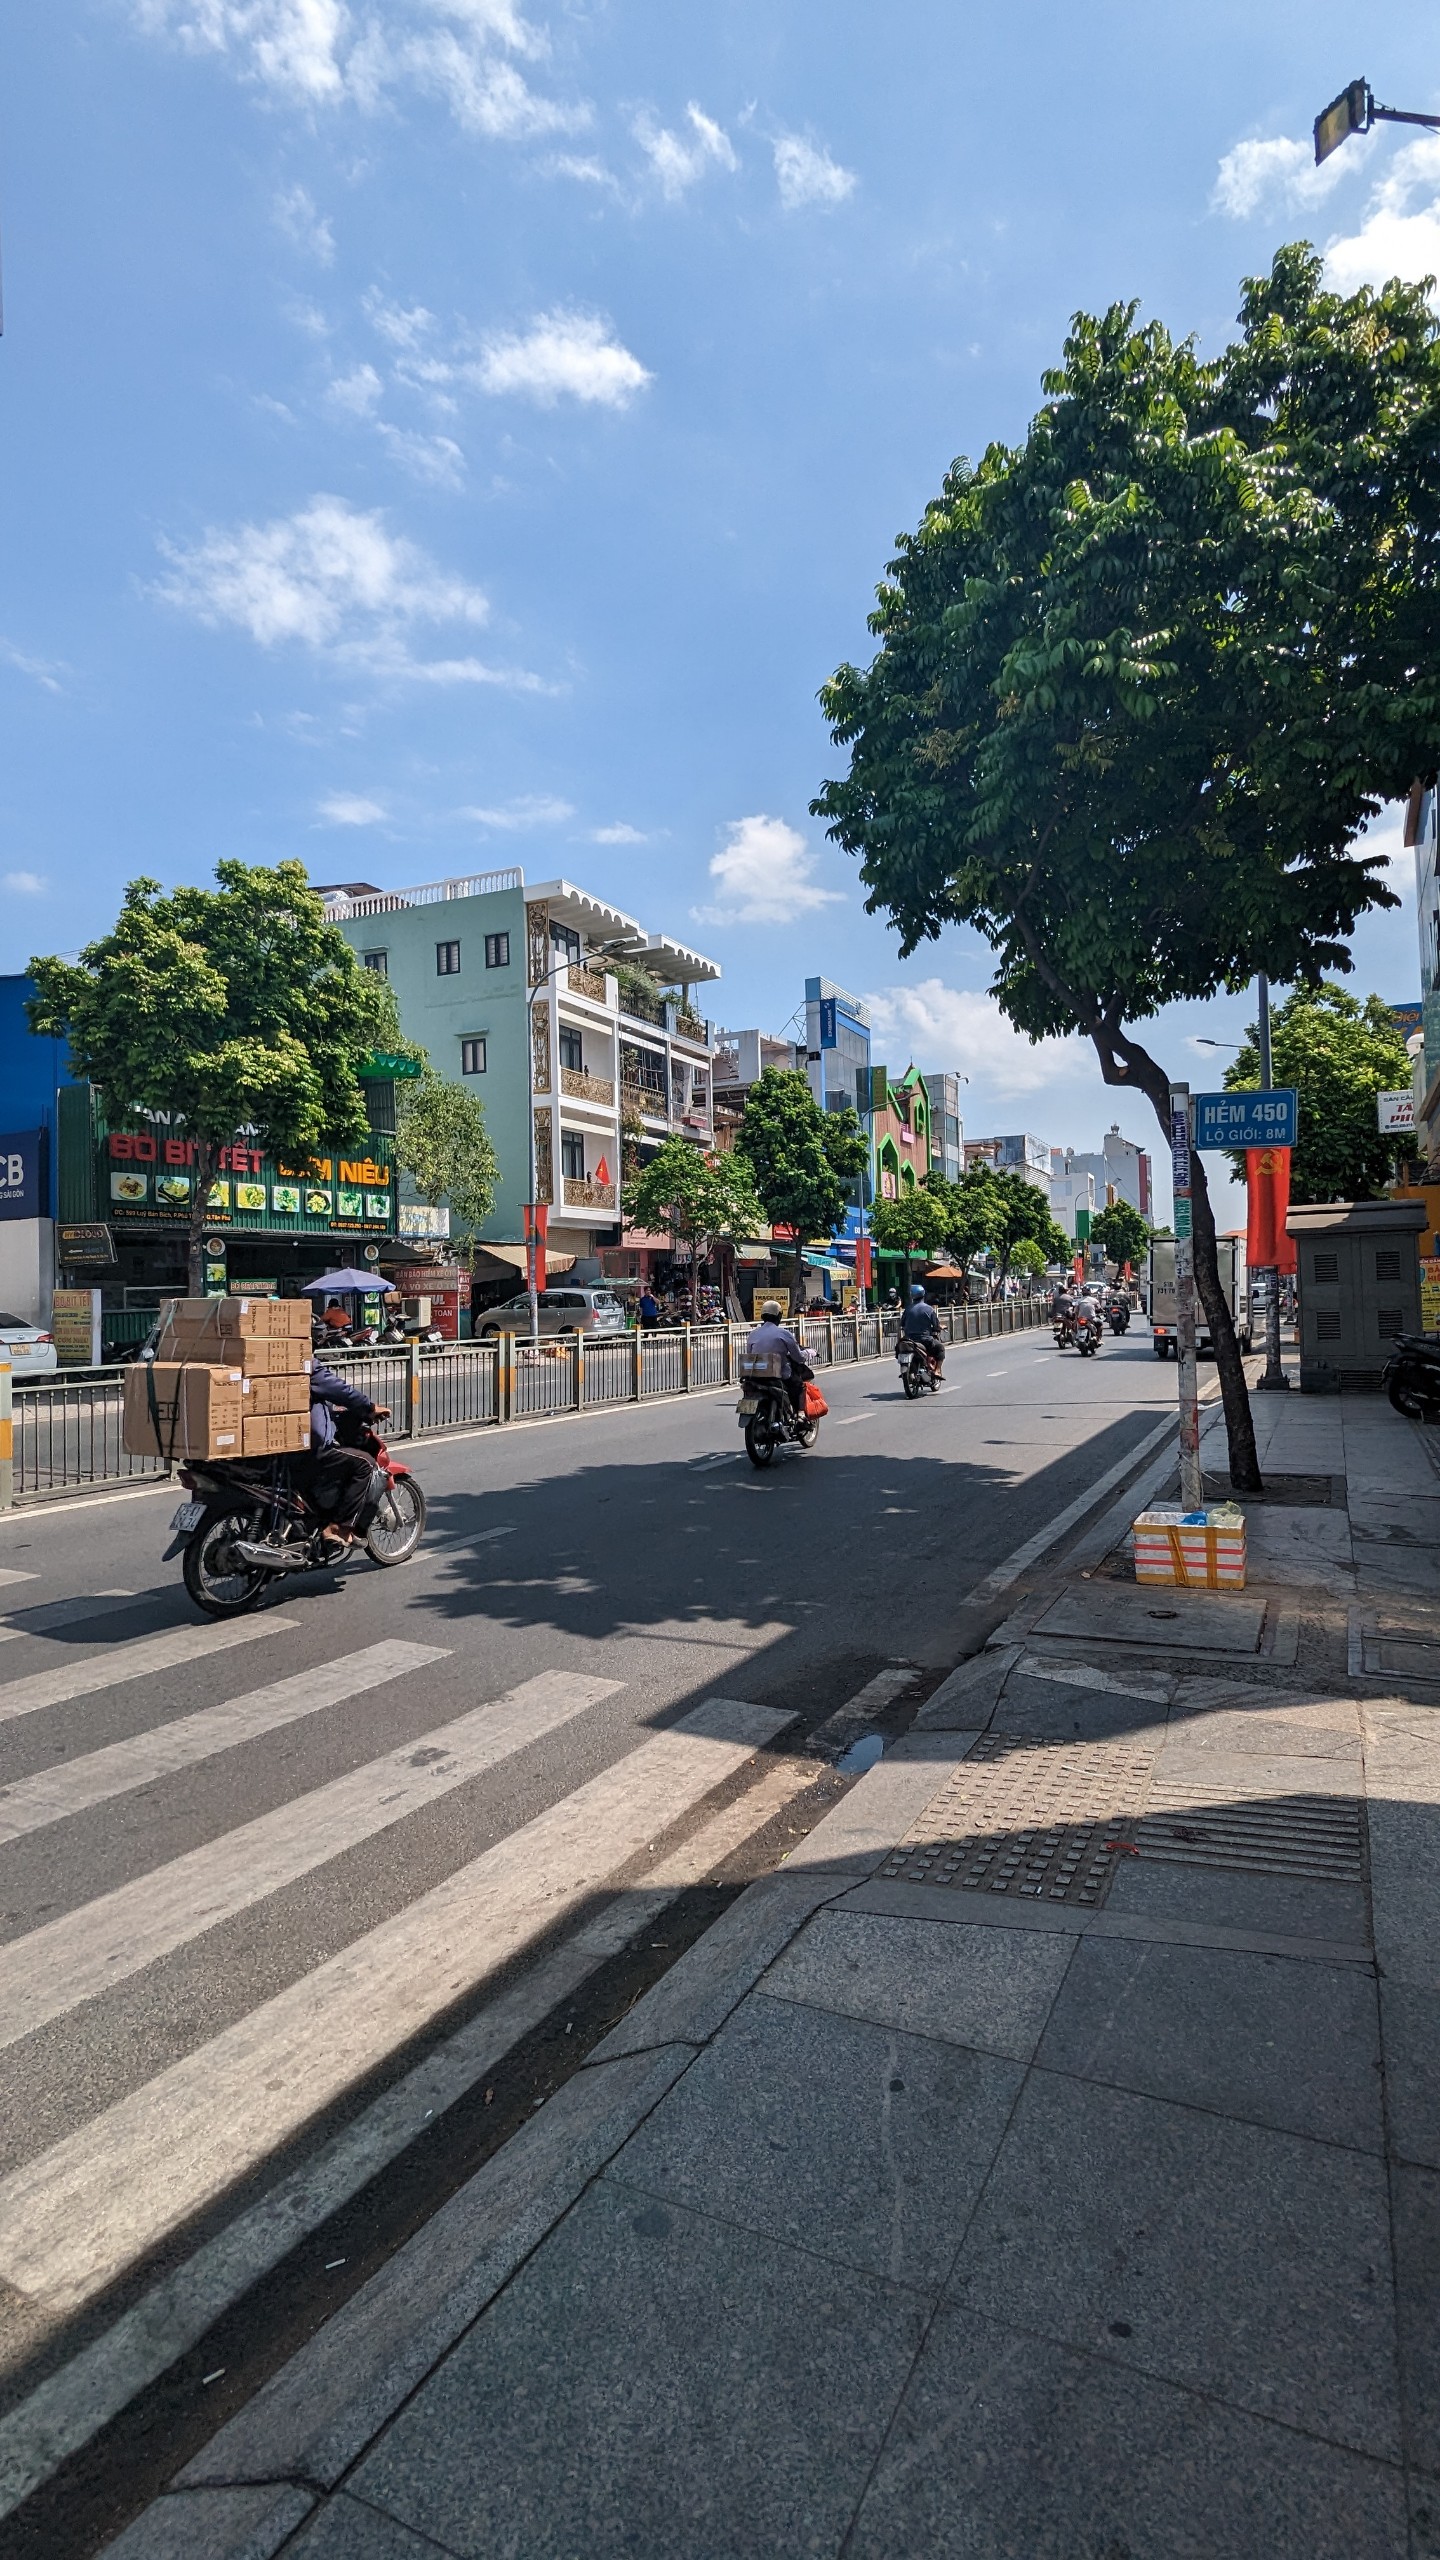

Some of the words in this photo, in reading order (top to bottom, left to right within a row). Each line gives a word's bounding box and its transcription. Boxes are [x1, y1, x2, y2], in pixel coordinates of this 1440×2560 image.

[1204, 1100, 1246, 1124] HẺM
[1251, 1102, 1288, 1122] 450
[1206, 1128, 1224, 1143] LỘ
[1228, 1126, 1262, 1141] GIỚI:
[1266, 1127, 1286, 1139] 8M
[218, 1136, 265, 1173] TẾT
[340, 1157, 389, 1186] NIÊU
